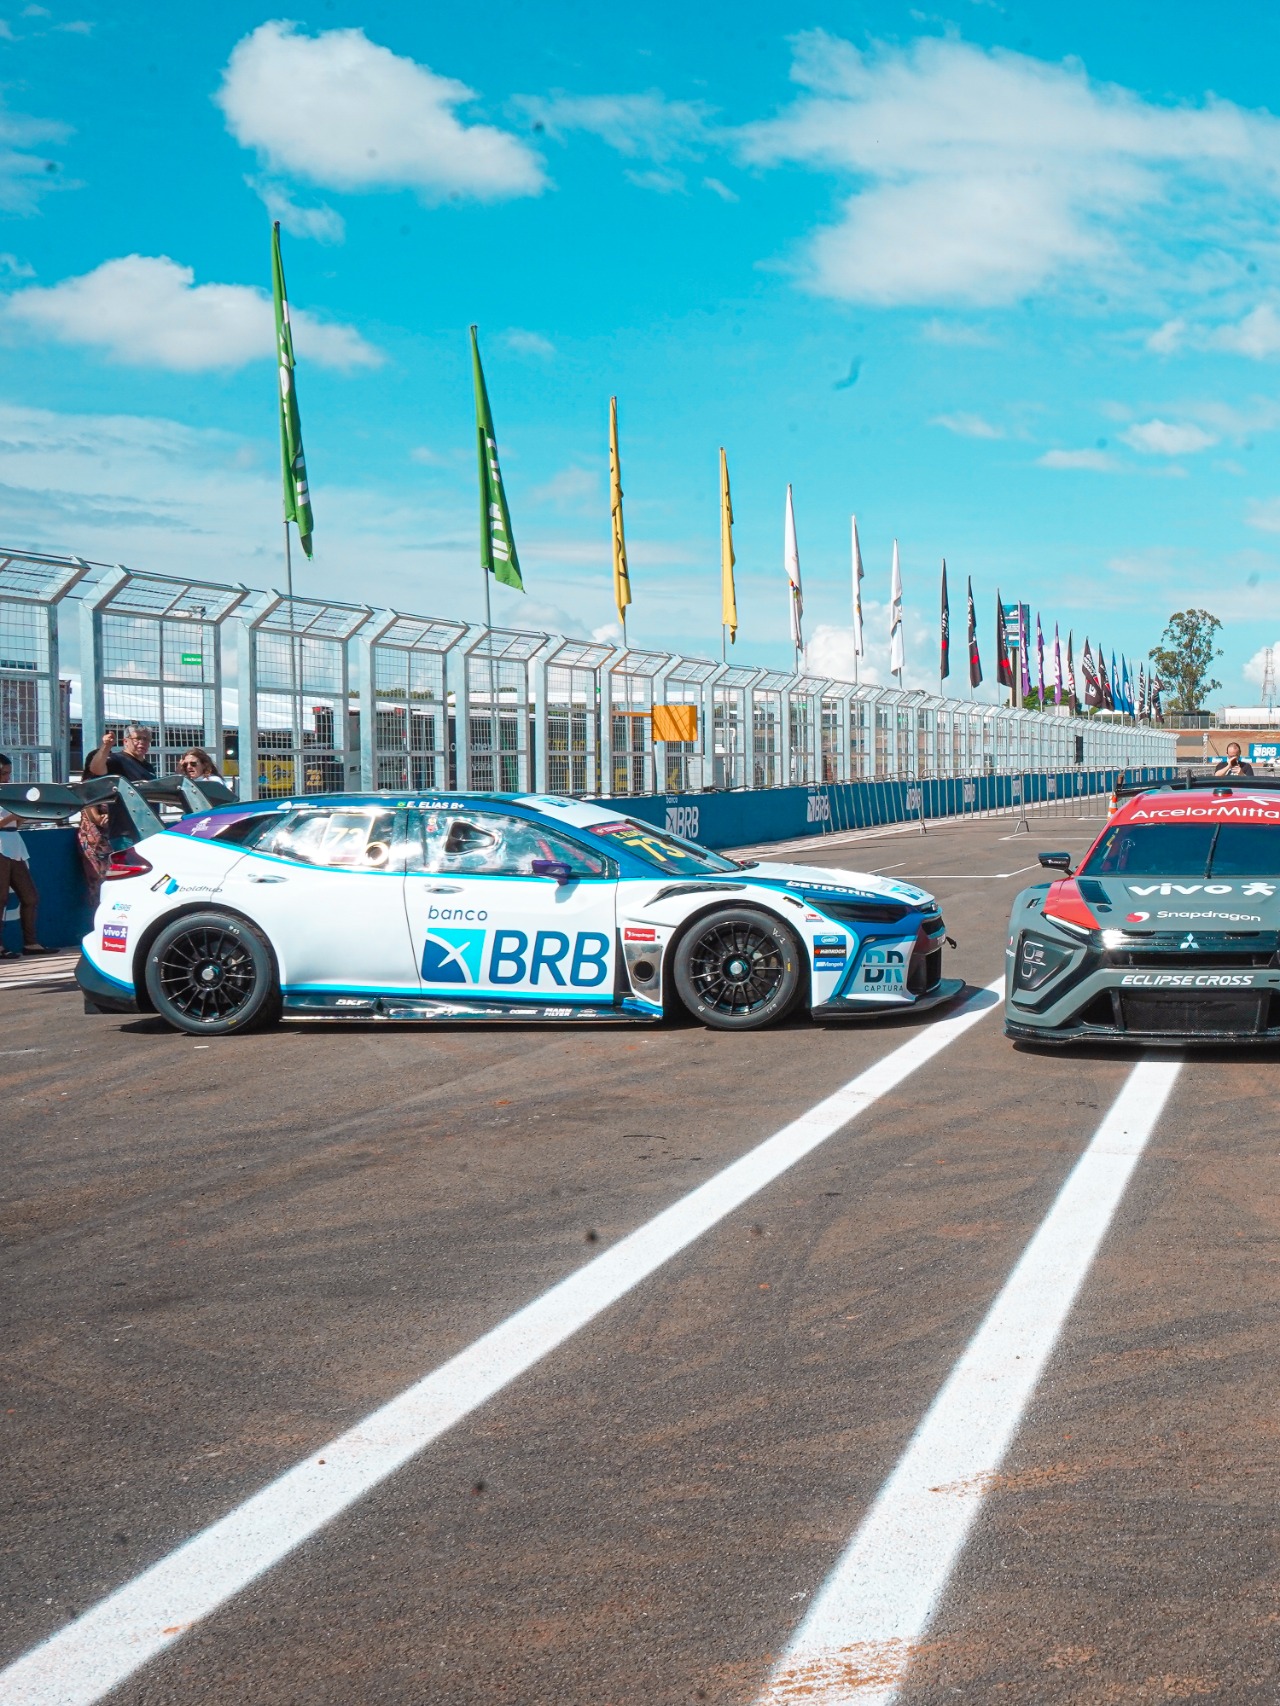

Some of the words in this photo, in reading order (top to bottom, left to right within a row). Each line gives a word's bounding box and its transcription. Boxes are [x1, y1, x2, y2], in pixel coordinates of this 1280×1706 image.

[418, 801, 449, 809] ELIAS
[676, 806, 699, 839] BRB
[622, 837, 686, 862] 73
[179, 885, 223, 893] boldhub
[1128, 883, 1233, 896] vivo
[427, 905, 488, 922] banco
[1156, 910, 1261, 922] Snapdragon
[103, 927, 120, 937] vivo
[488, 929, 610, 987] BRB
[1121, 975, 1195, 986] ECLIPSE
[1196, 975, 1254, 986] CROSS
